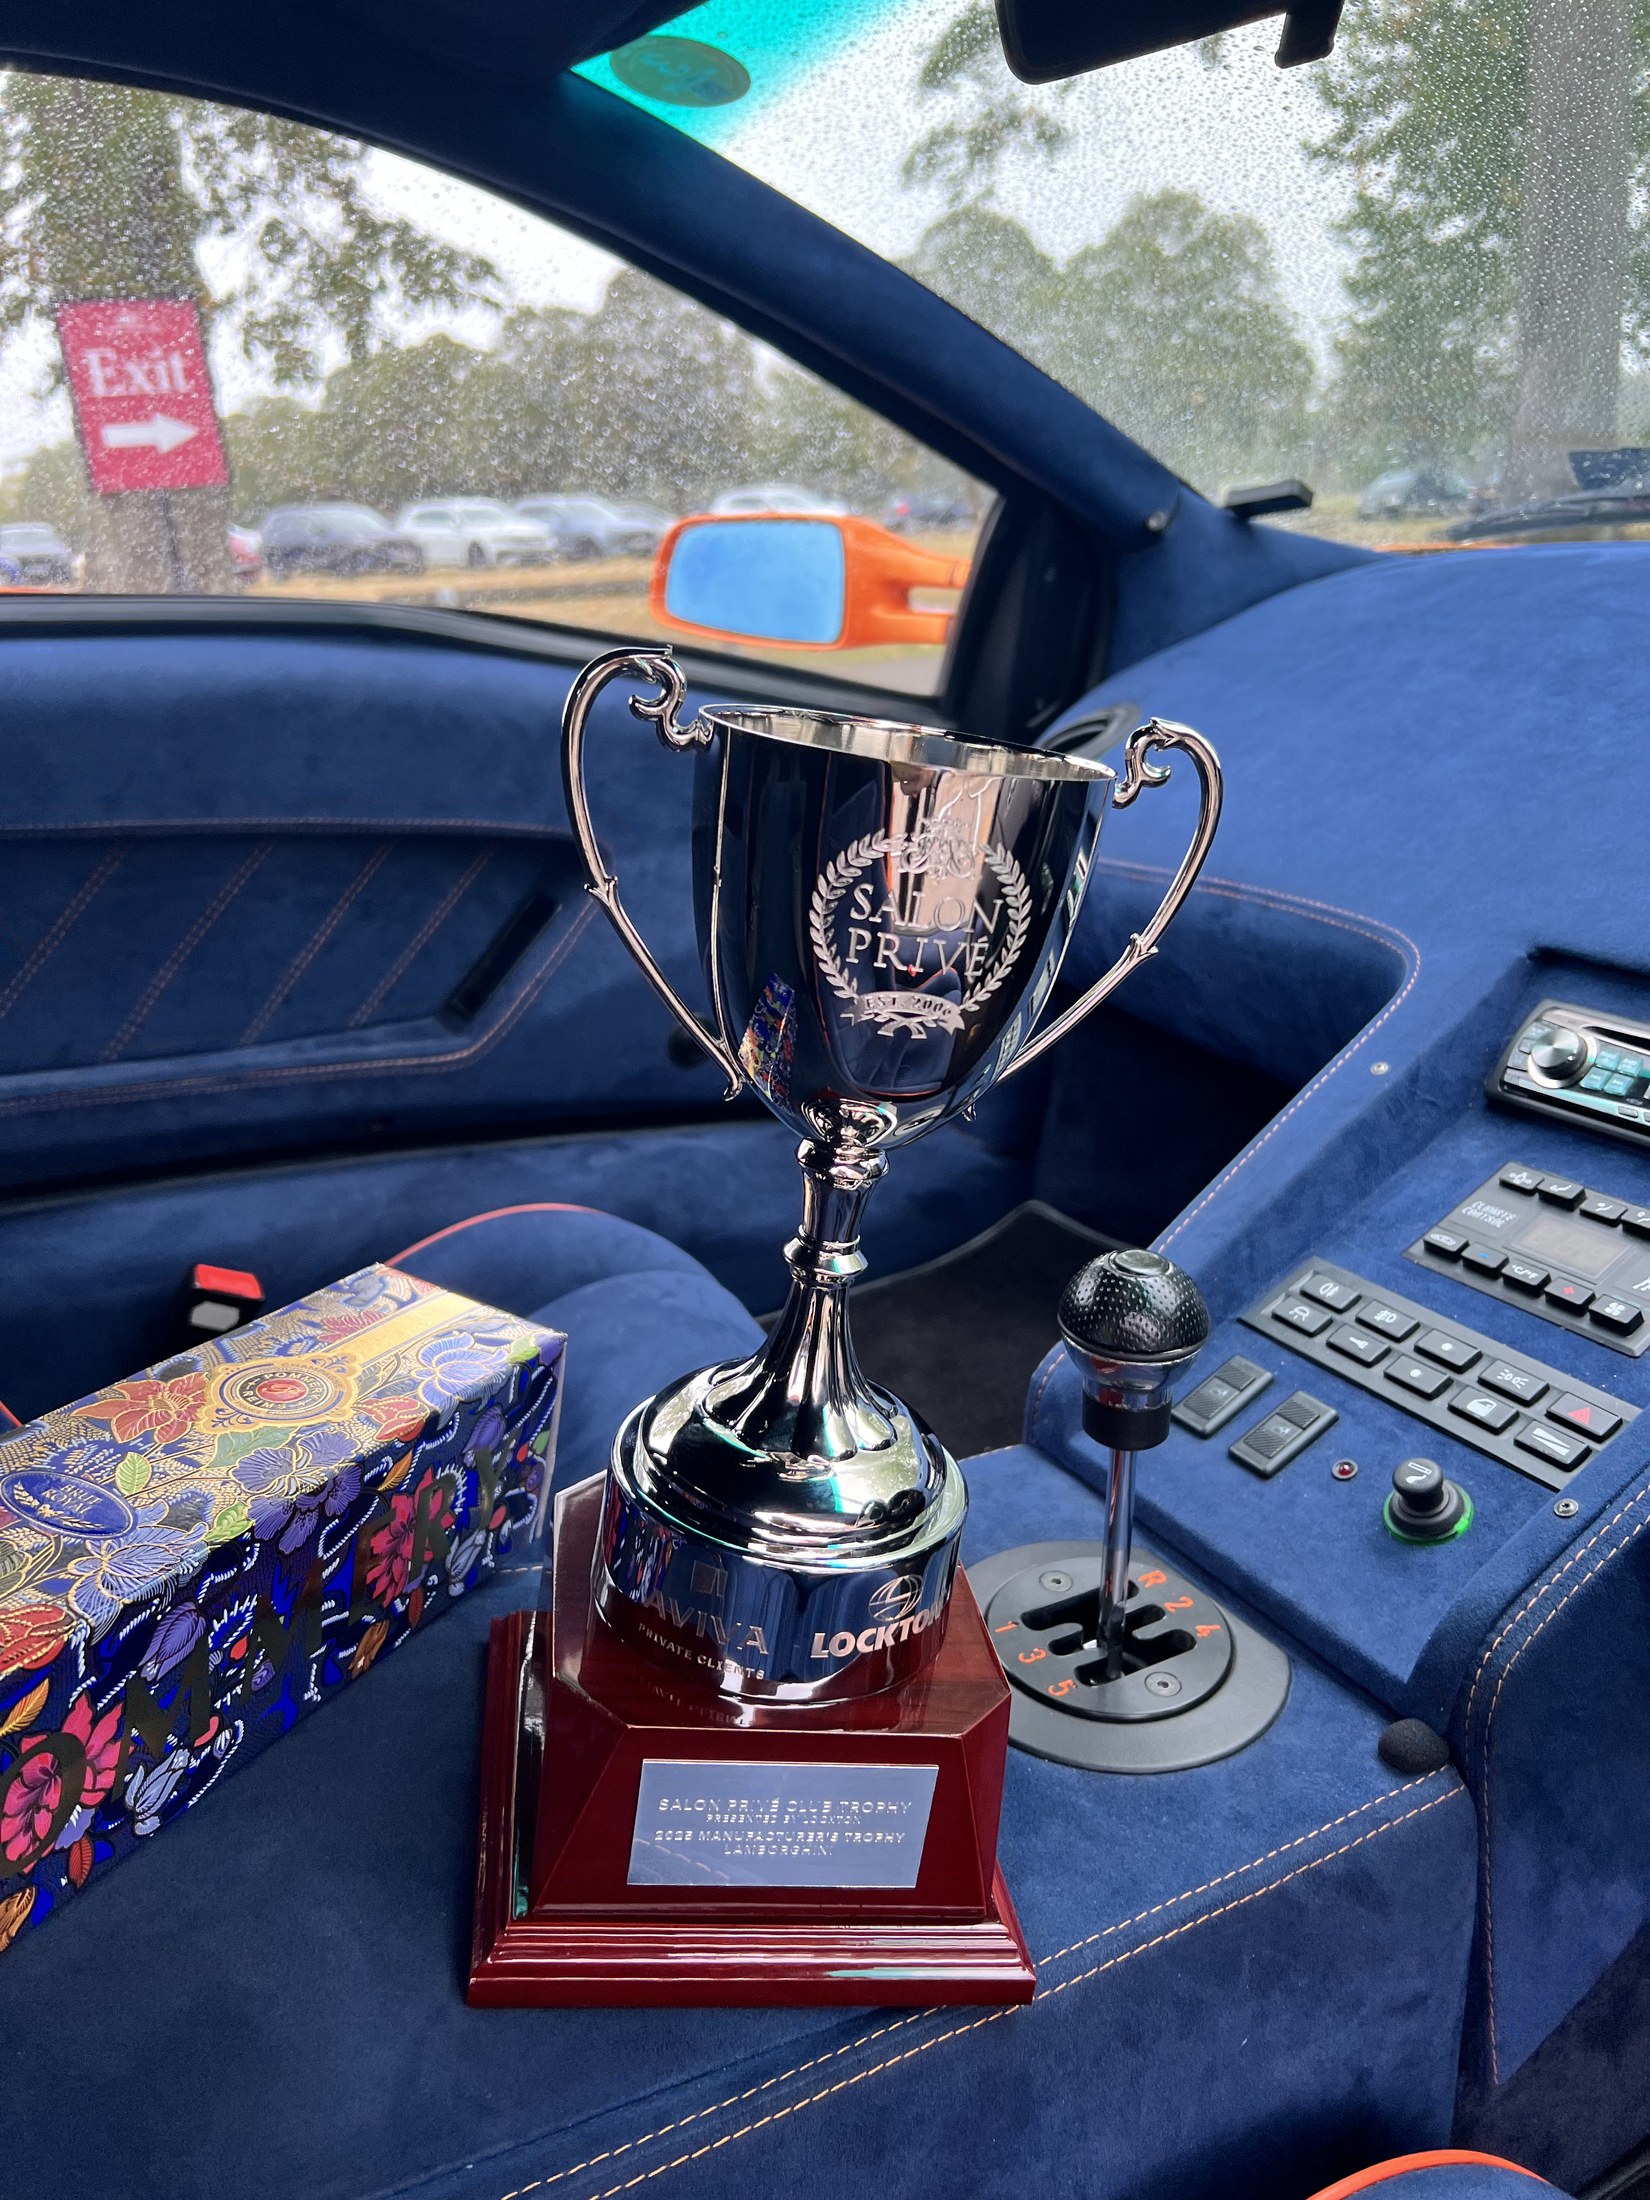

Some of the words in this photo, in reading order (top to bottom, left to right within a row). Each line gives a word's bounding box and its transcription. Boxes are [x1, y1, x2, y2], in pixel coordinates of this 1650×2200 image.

[82, 345, 193, 395] Exit
[850, 883, 1004, 934] SALON
[845, 926, 990, 977] PRIVÉ
[864, 996, 904, 1009] EST.
[910, 996, 952, 1016] 2006
[263, 1371, 323, 1401] POMMERY
[242, 1389, 287, 1409] REIMS
[60, 1484, 103, 1505] BRUT
[1138, 1569, 1168, 1589] R
[1164, 1596, 1194, 1613] 2
[643, 1590, 769, 1655] AVIVA
[810, 1600, 944, 1658] LOCKTON
[1194, 1624, 1222, 1638] 4
[0, 1427, 523, 1878] OMMERY
[638, 1622, 692, 1661] PRIVATE
[697, 1655, 765, 1680] CLIENTS
[1017, 1647, 1047, 1664] 3
[1047, 1679, 1078, 1697] 5
[658, 1798, 721, 1812] SALON
[727, 1797, 780, 1813] PRIVÉ
[786, 1800, 832, 1813] CLUB
[839, 1801, 912, 1814] TROPHY
[705, 1814, 777, 1824] PRESENTED
[783, 1814, 799, 1824] BY
[803, 1815, 862, 1825] LOCKTON
[698, 1830, 839, 1843] MANUFACTURER'S
[844, 1831, 906, 1844] TROPHY
[724, 1845, 833, 1856] LAMBORGHINI
